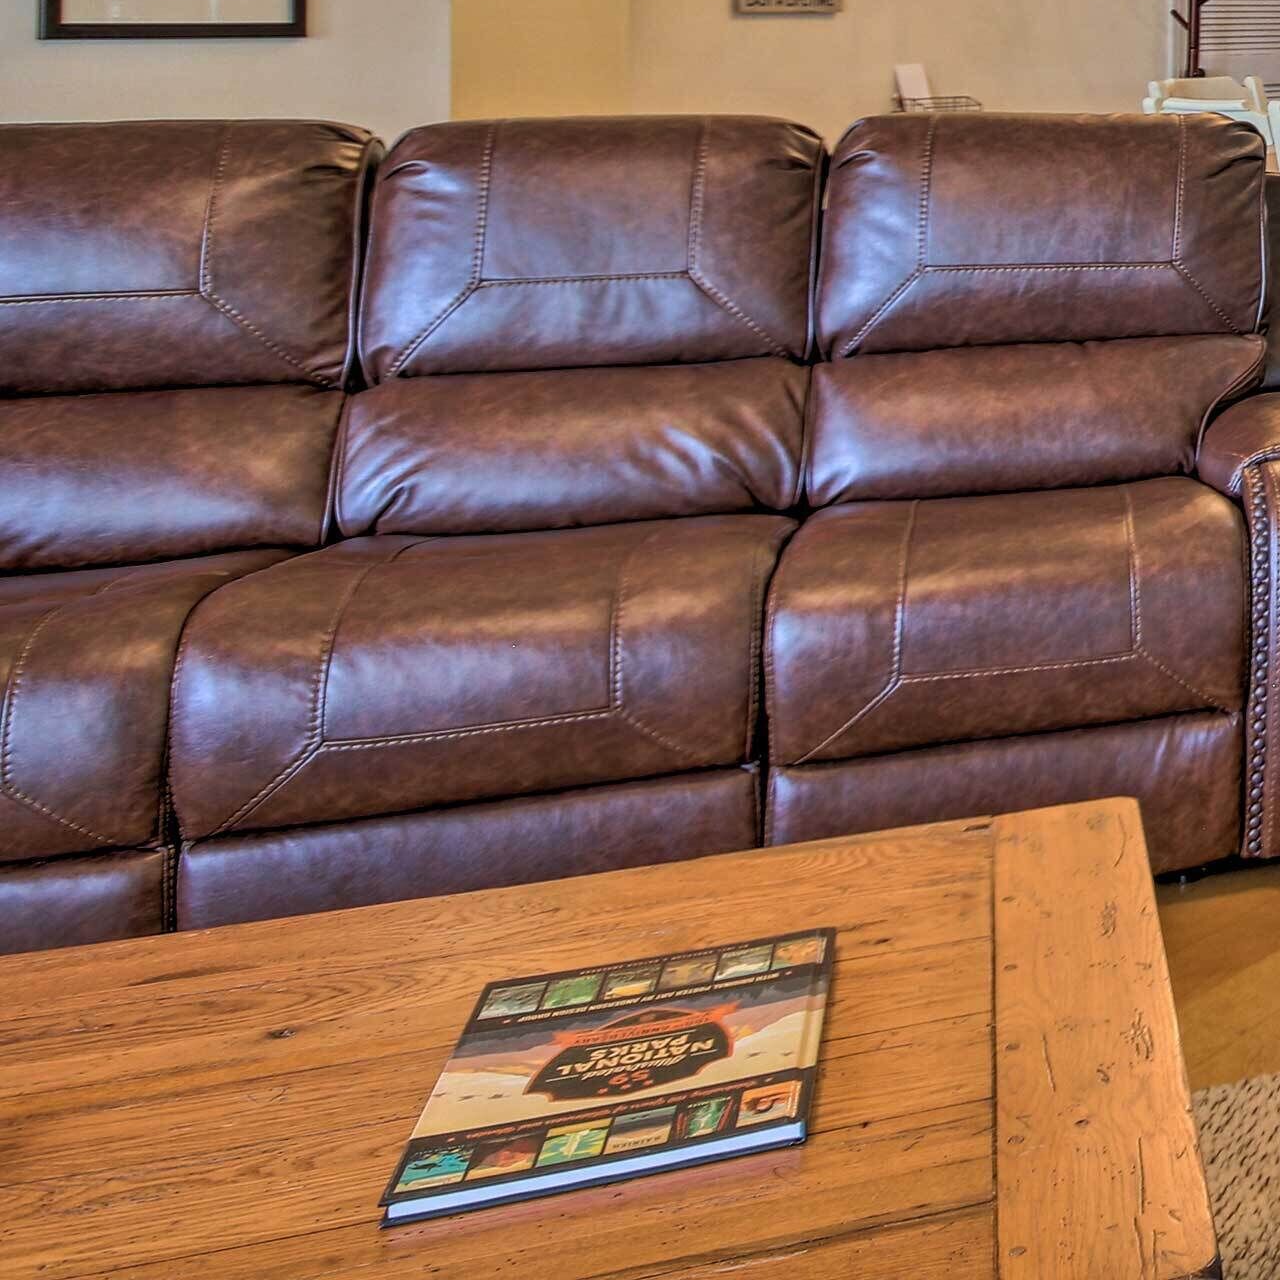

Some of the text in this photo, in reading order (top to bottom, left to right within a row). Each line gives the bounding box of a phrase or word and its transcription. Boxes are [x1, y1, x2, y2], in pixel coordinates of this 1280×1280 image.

[551, 1006, 587, 1017] DESIGN
[588, 998, 640, 1011] ANDERSON
[517, 1013, 551, 1023] GROUP
[590, 1034, 689, 1061] PARKS
[556, 1038, 715, 1075] NATIONAL
[581, 1054, 687, 1080] Illustrated
[608, 1071, 650, 1085] 59
